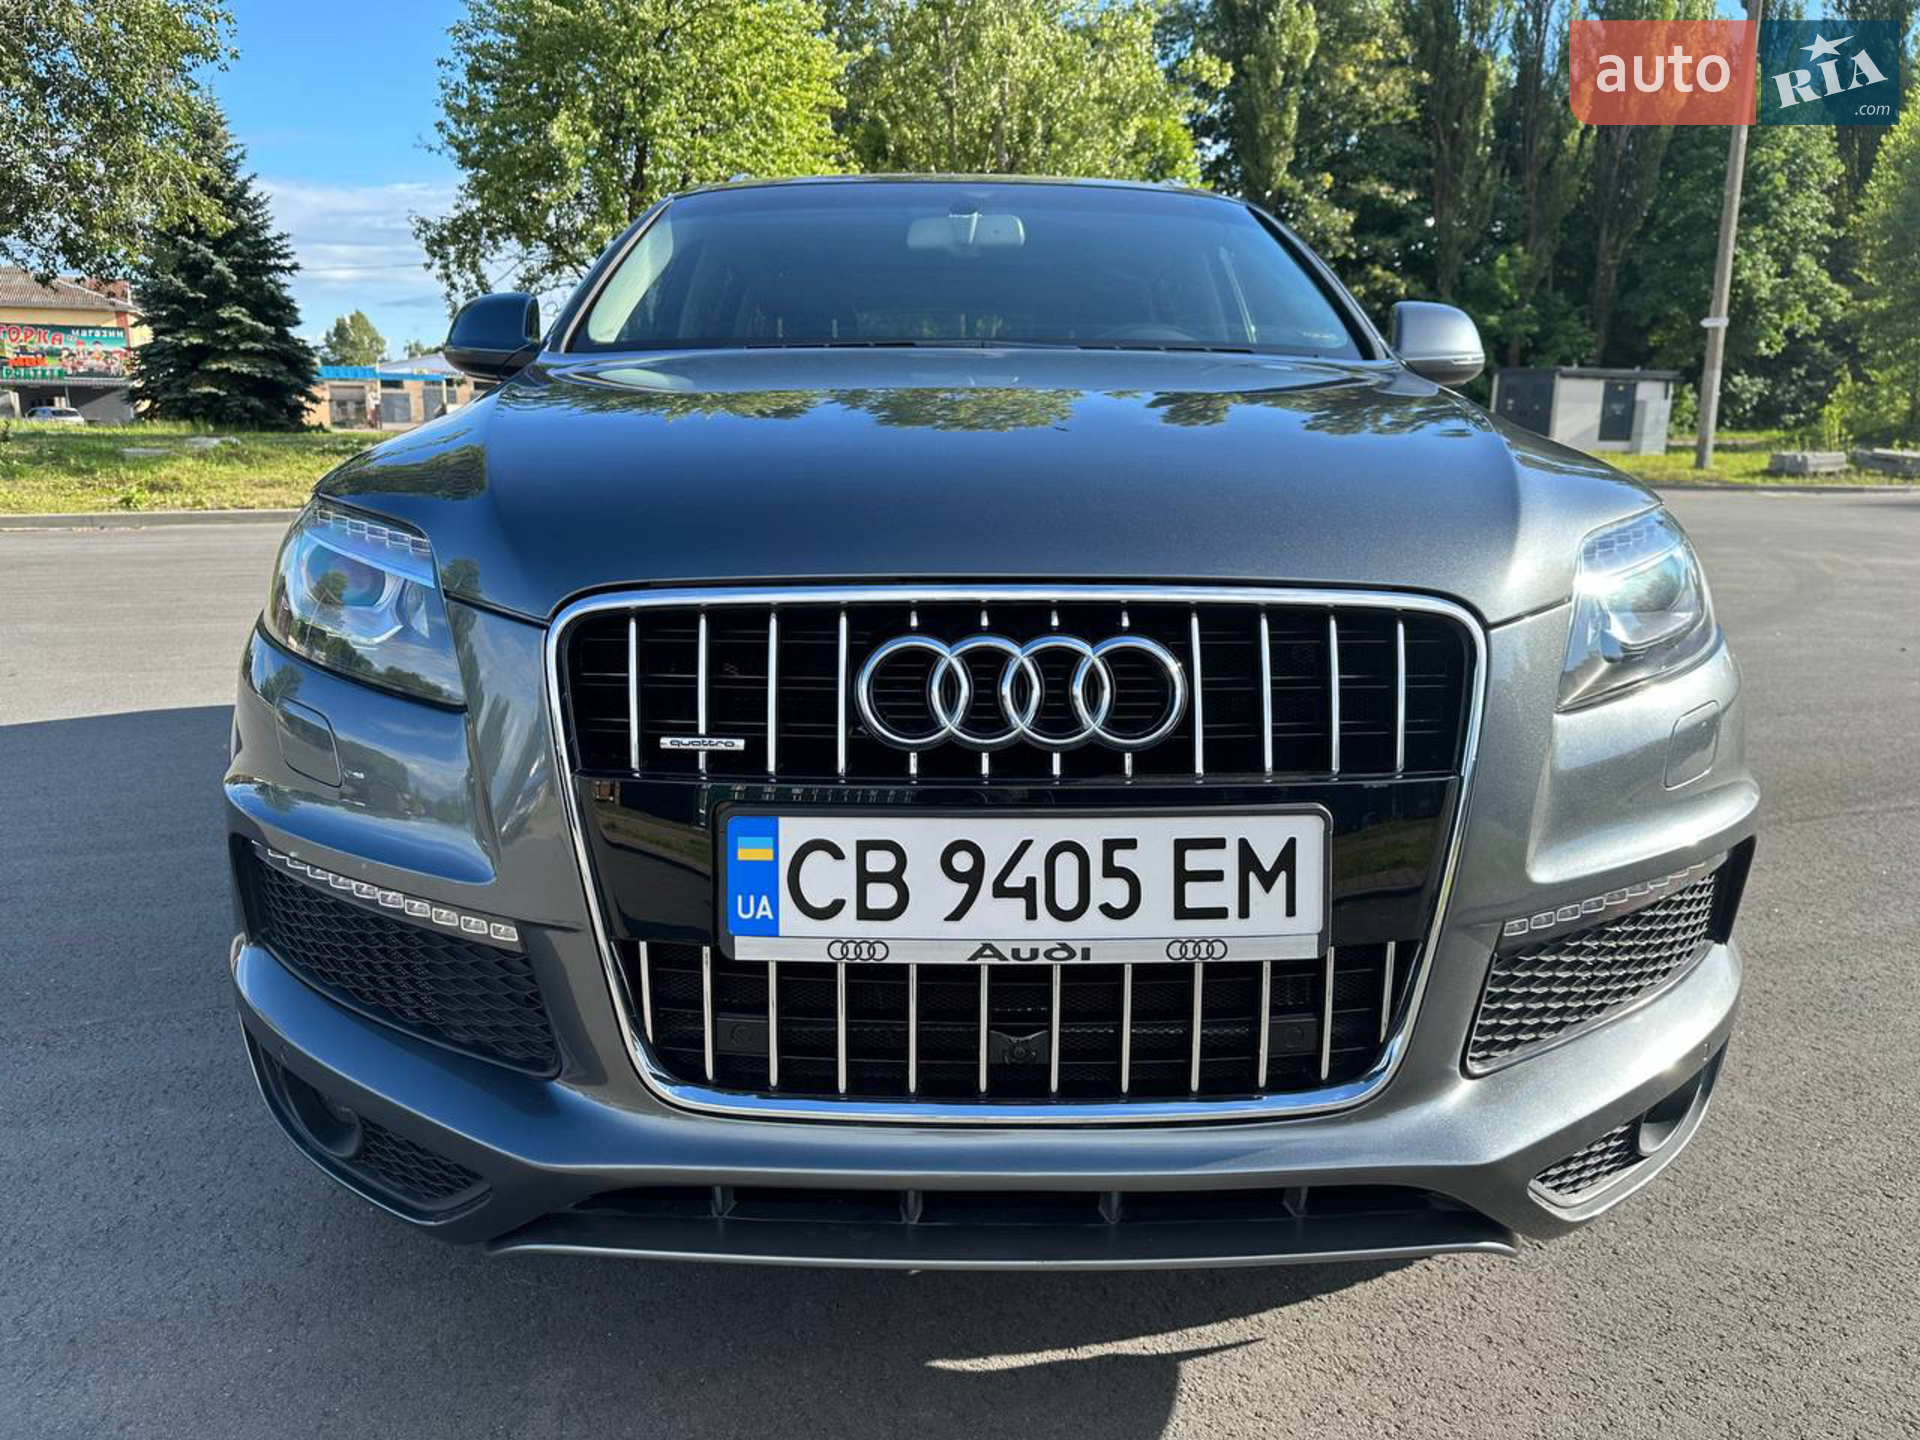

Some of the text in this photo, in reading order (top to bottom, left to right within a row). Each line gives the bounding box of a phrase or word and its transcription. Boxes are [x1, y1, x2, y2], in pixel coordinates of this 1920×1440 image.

[669, 739, 736, 748] quattro
[787, 837, 1297, 922] CB 9405 EM
[738, 896, 773, 918] UA
[967, 943, 1092, 965] Audi
